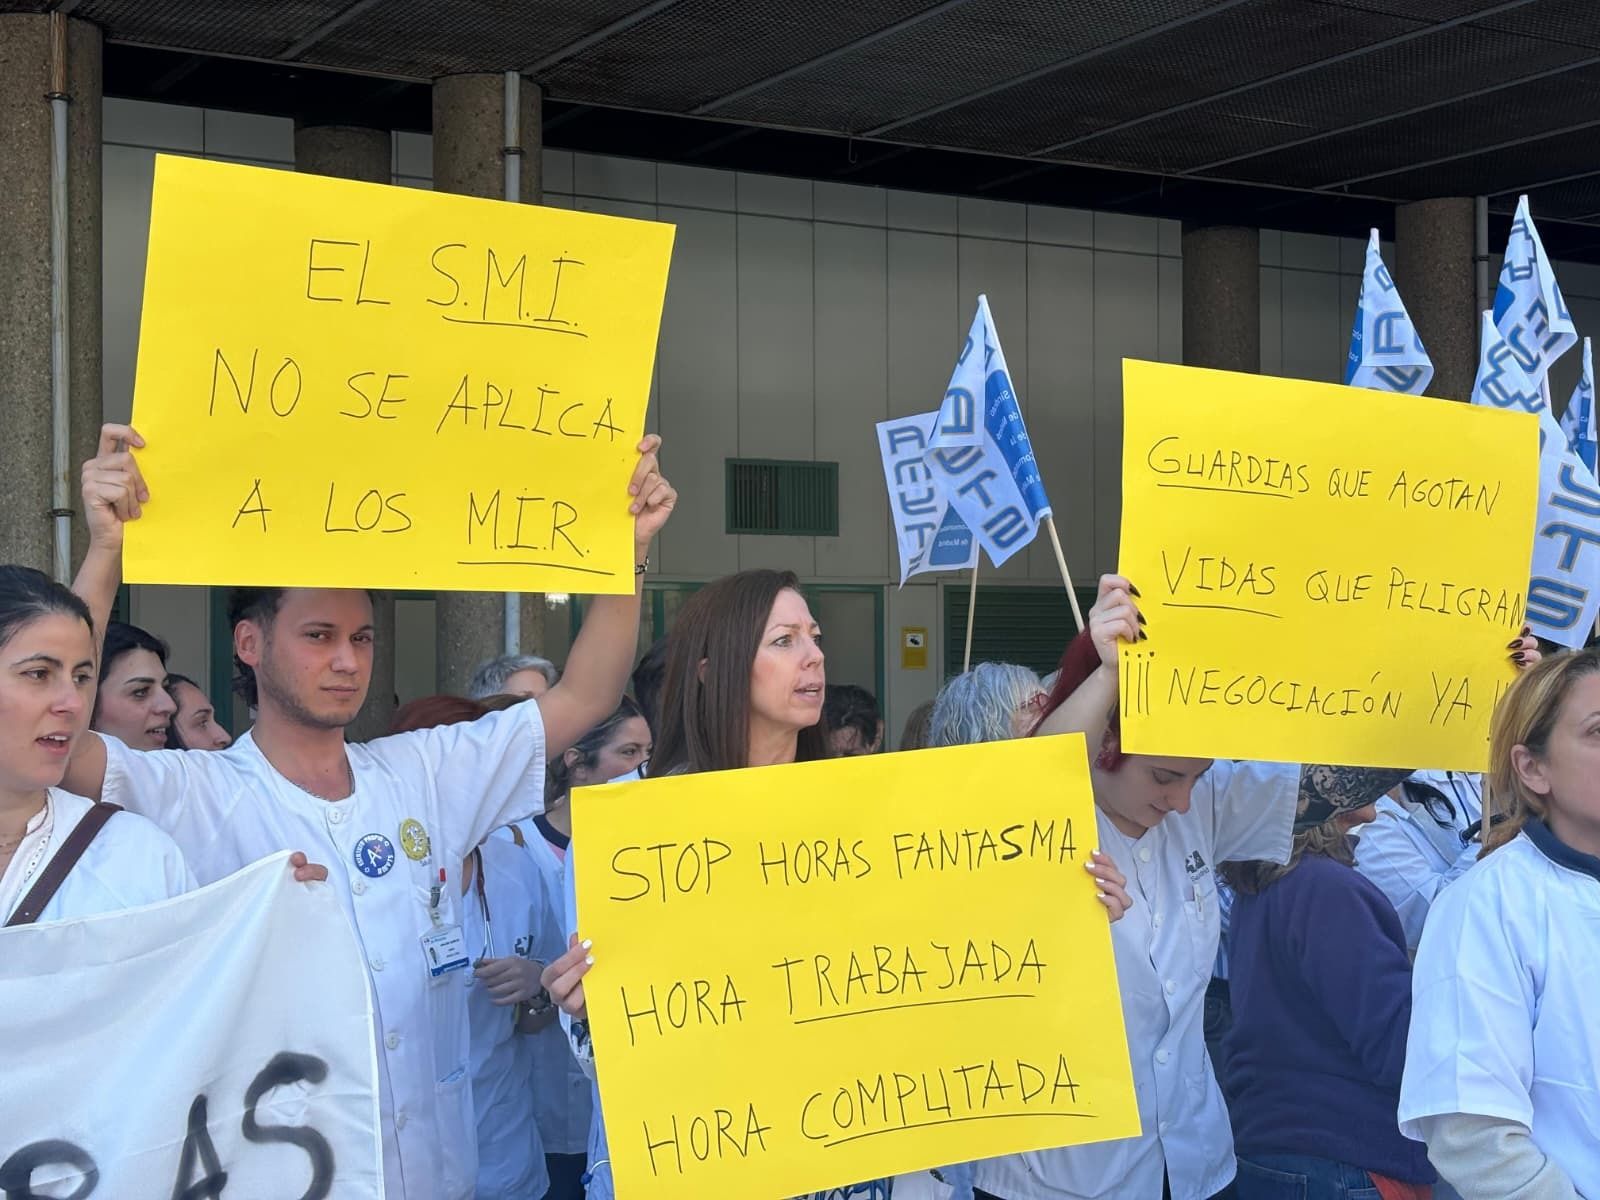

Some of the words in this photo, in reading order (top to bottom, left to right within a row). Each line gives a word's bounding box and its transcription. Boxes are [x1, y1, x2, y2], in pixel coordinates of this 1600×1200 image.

[307, 239, 390, 305] EL
[210, 349, 301, 417] NO
[340, 372, 408, 419] SE
[436, 375, 624, 441] APLICA
[232, 479, 272, 532] A
[325, 482, 411, 533] LOS
[1148, 437, 1309, 492] GUARDIAS
[1329, 469, 1372, 497] QUE
[1389, 471, 1500, 515] AGOTAN
[1162, 547, 1275, 595] VIDAS
[1306, 570, 1372, 603] QUE
[1388, 567, 1526, 630] PELIGRAN
[1168, 667, 1401, 718] NEGOCIACIÓN
[1430, 672, 1472, 726] YA
[610, 837, 731, 902] STOP
[760, 838, 871, 885] HORAS
[894, 818, 1076, 879] FANTASMA
[621, 975, 746, 1046] HORA
[772, 939, 1047, 1015] TRABAJADA
[643, 1103, 771, 1176] HORA
[802, 1054, 1080, 1139] COMPUTADA
